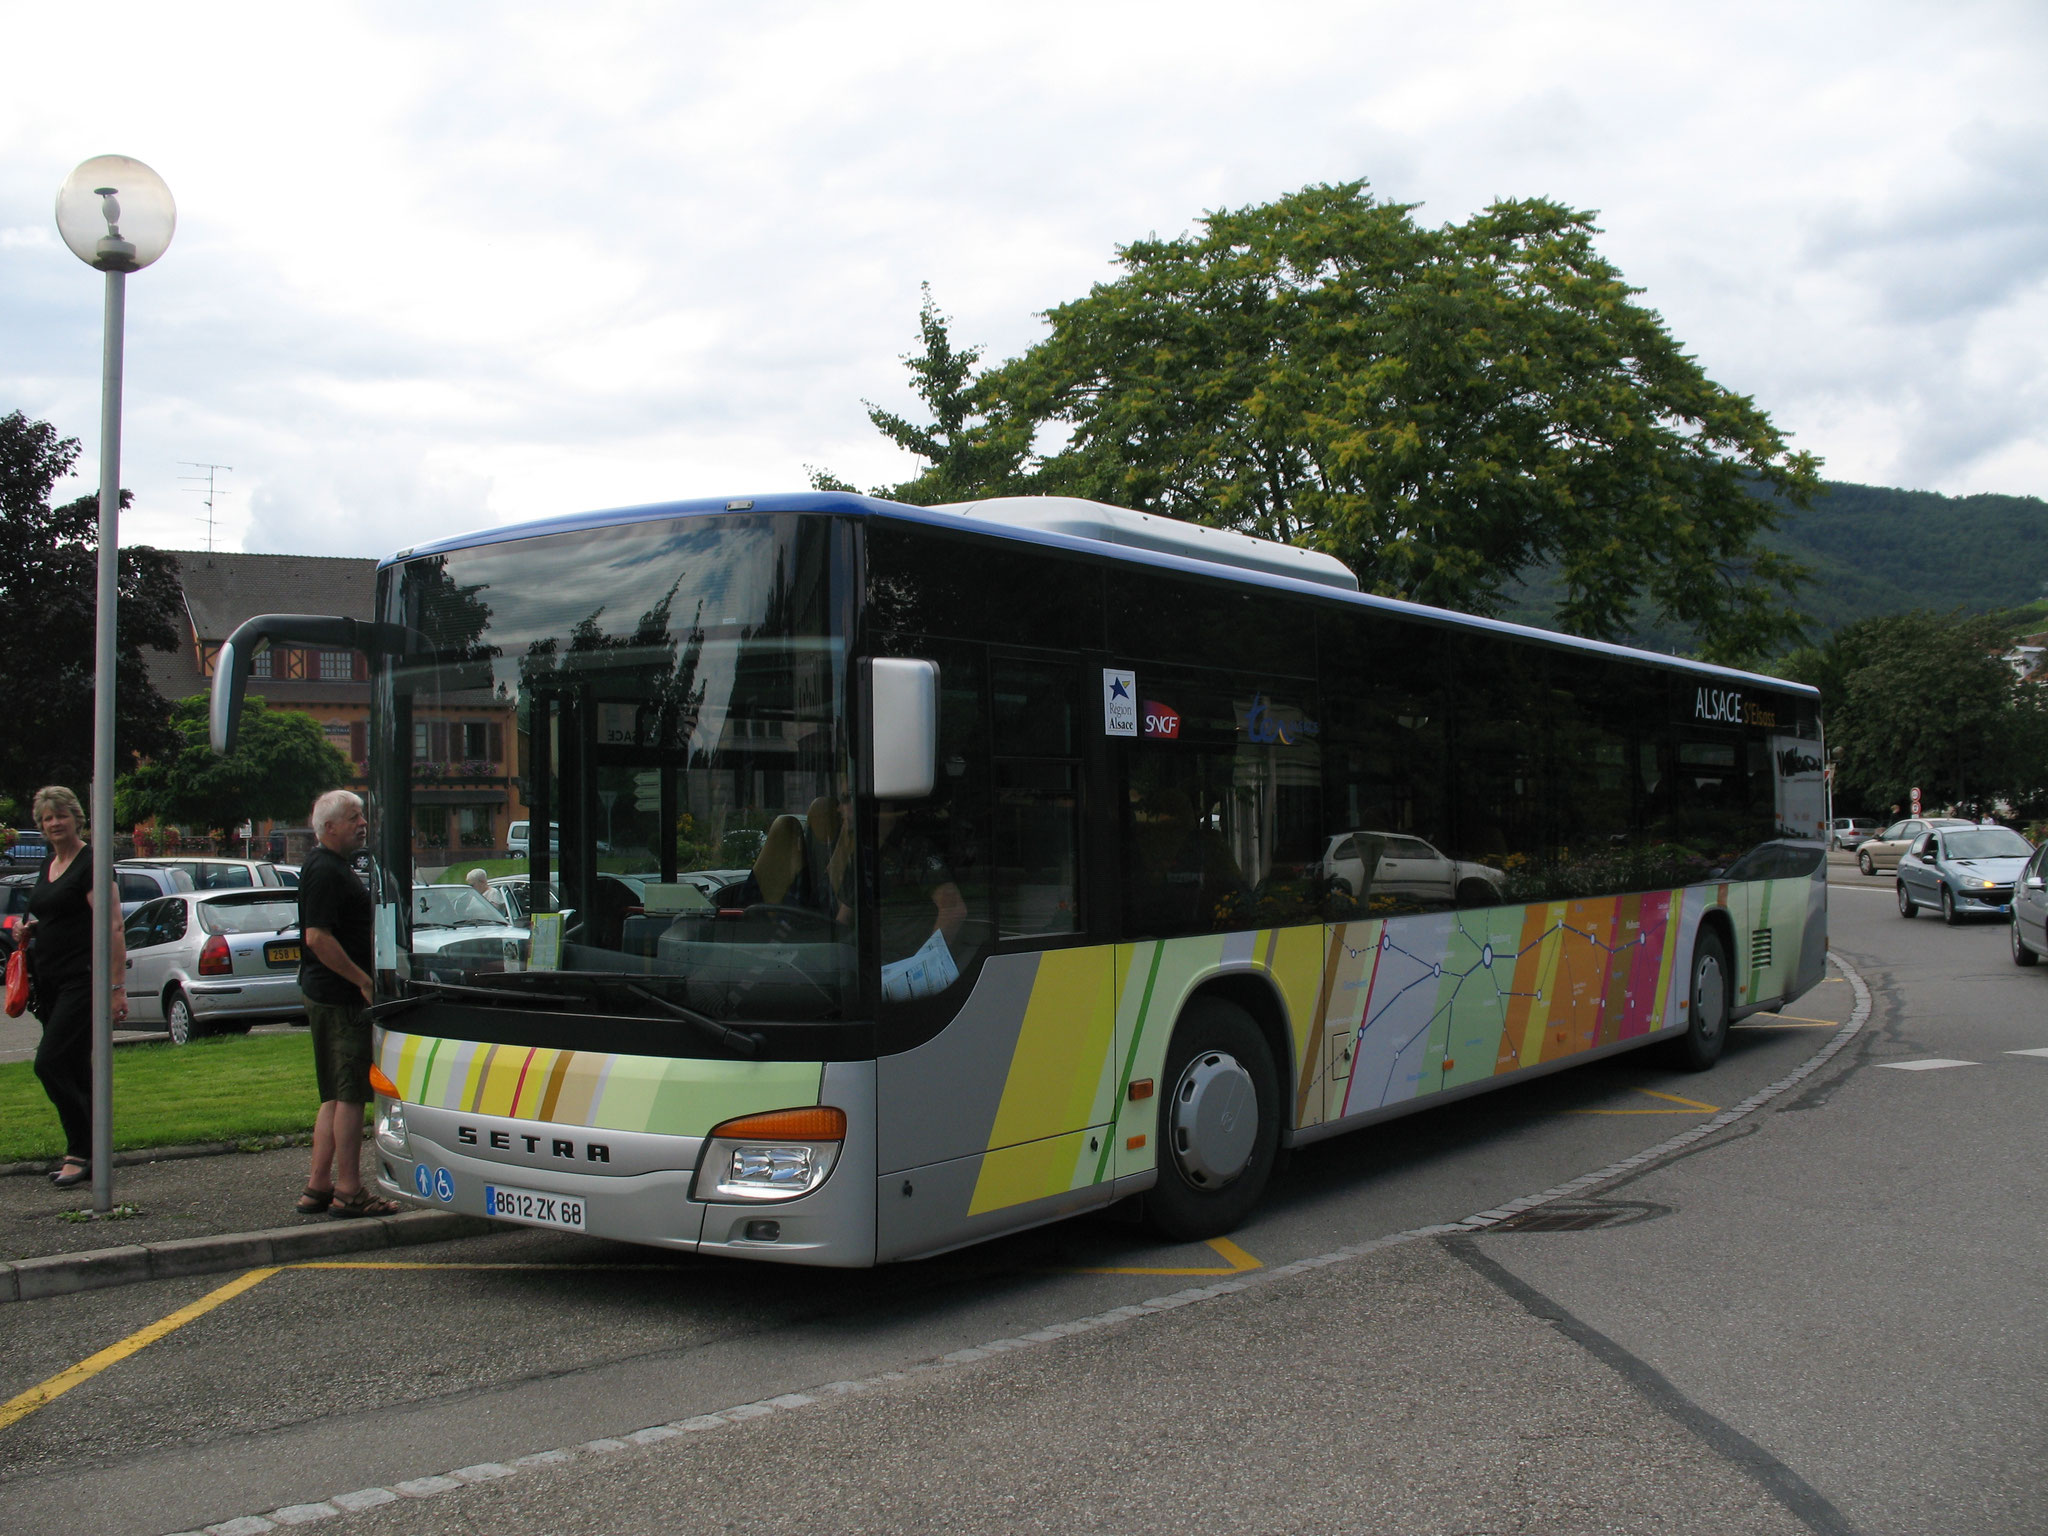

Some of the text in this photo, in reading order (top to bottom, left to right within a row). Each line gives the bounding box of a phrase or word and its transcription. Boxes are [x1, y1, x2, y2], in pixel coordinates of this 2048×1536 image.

[1109, 703, 1132, 719] Région
[1695, 686, 1743, 724] ALSACE
[1109, 717, 1134, 731] Alsace
[1145, 715, 1178, 733] SNCF
[458, 1126, 611, 1164] SETRA
[496, 1191, 533, 1218] 8612
[537, 1197, 557, 1222] ZK
[561, 1201, 582, 1226] 68
